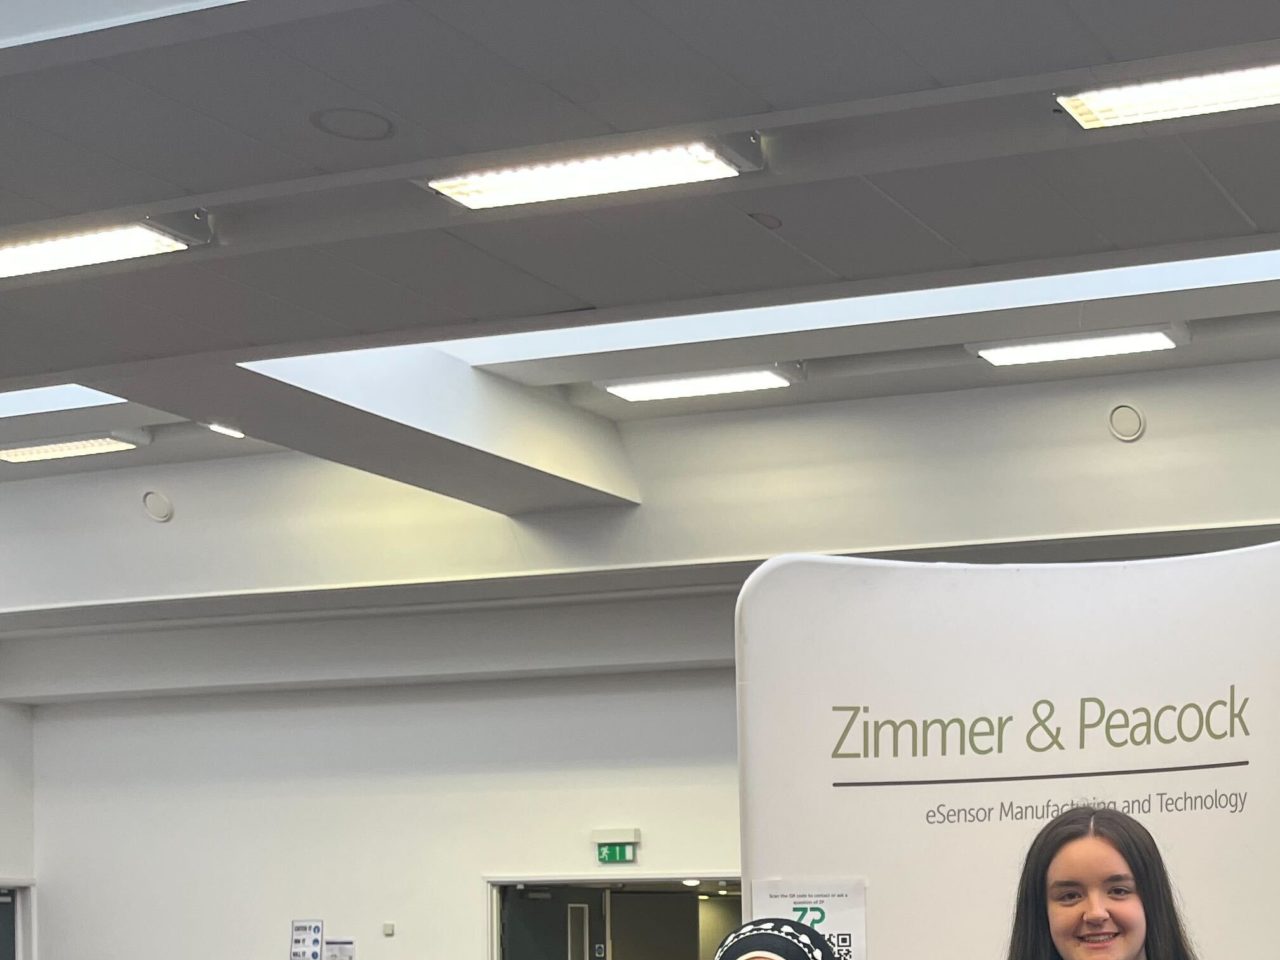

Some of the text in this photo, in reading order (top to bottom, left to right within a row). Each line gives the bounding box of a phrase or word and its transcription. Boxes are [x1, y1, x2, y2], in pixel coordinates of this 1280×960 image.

[831, 684, 1250, 760] Zimmer & Peacock
[925, 789, 1247, 825] eSensor Manufacin and Technology
